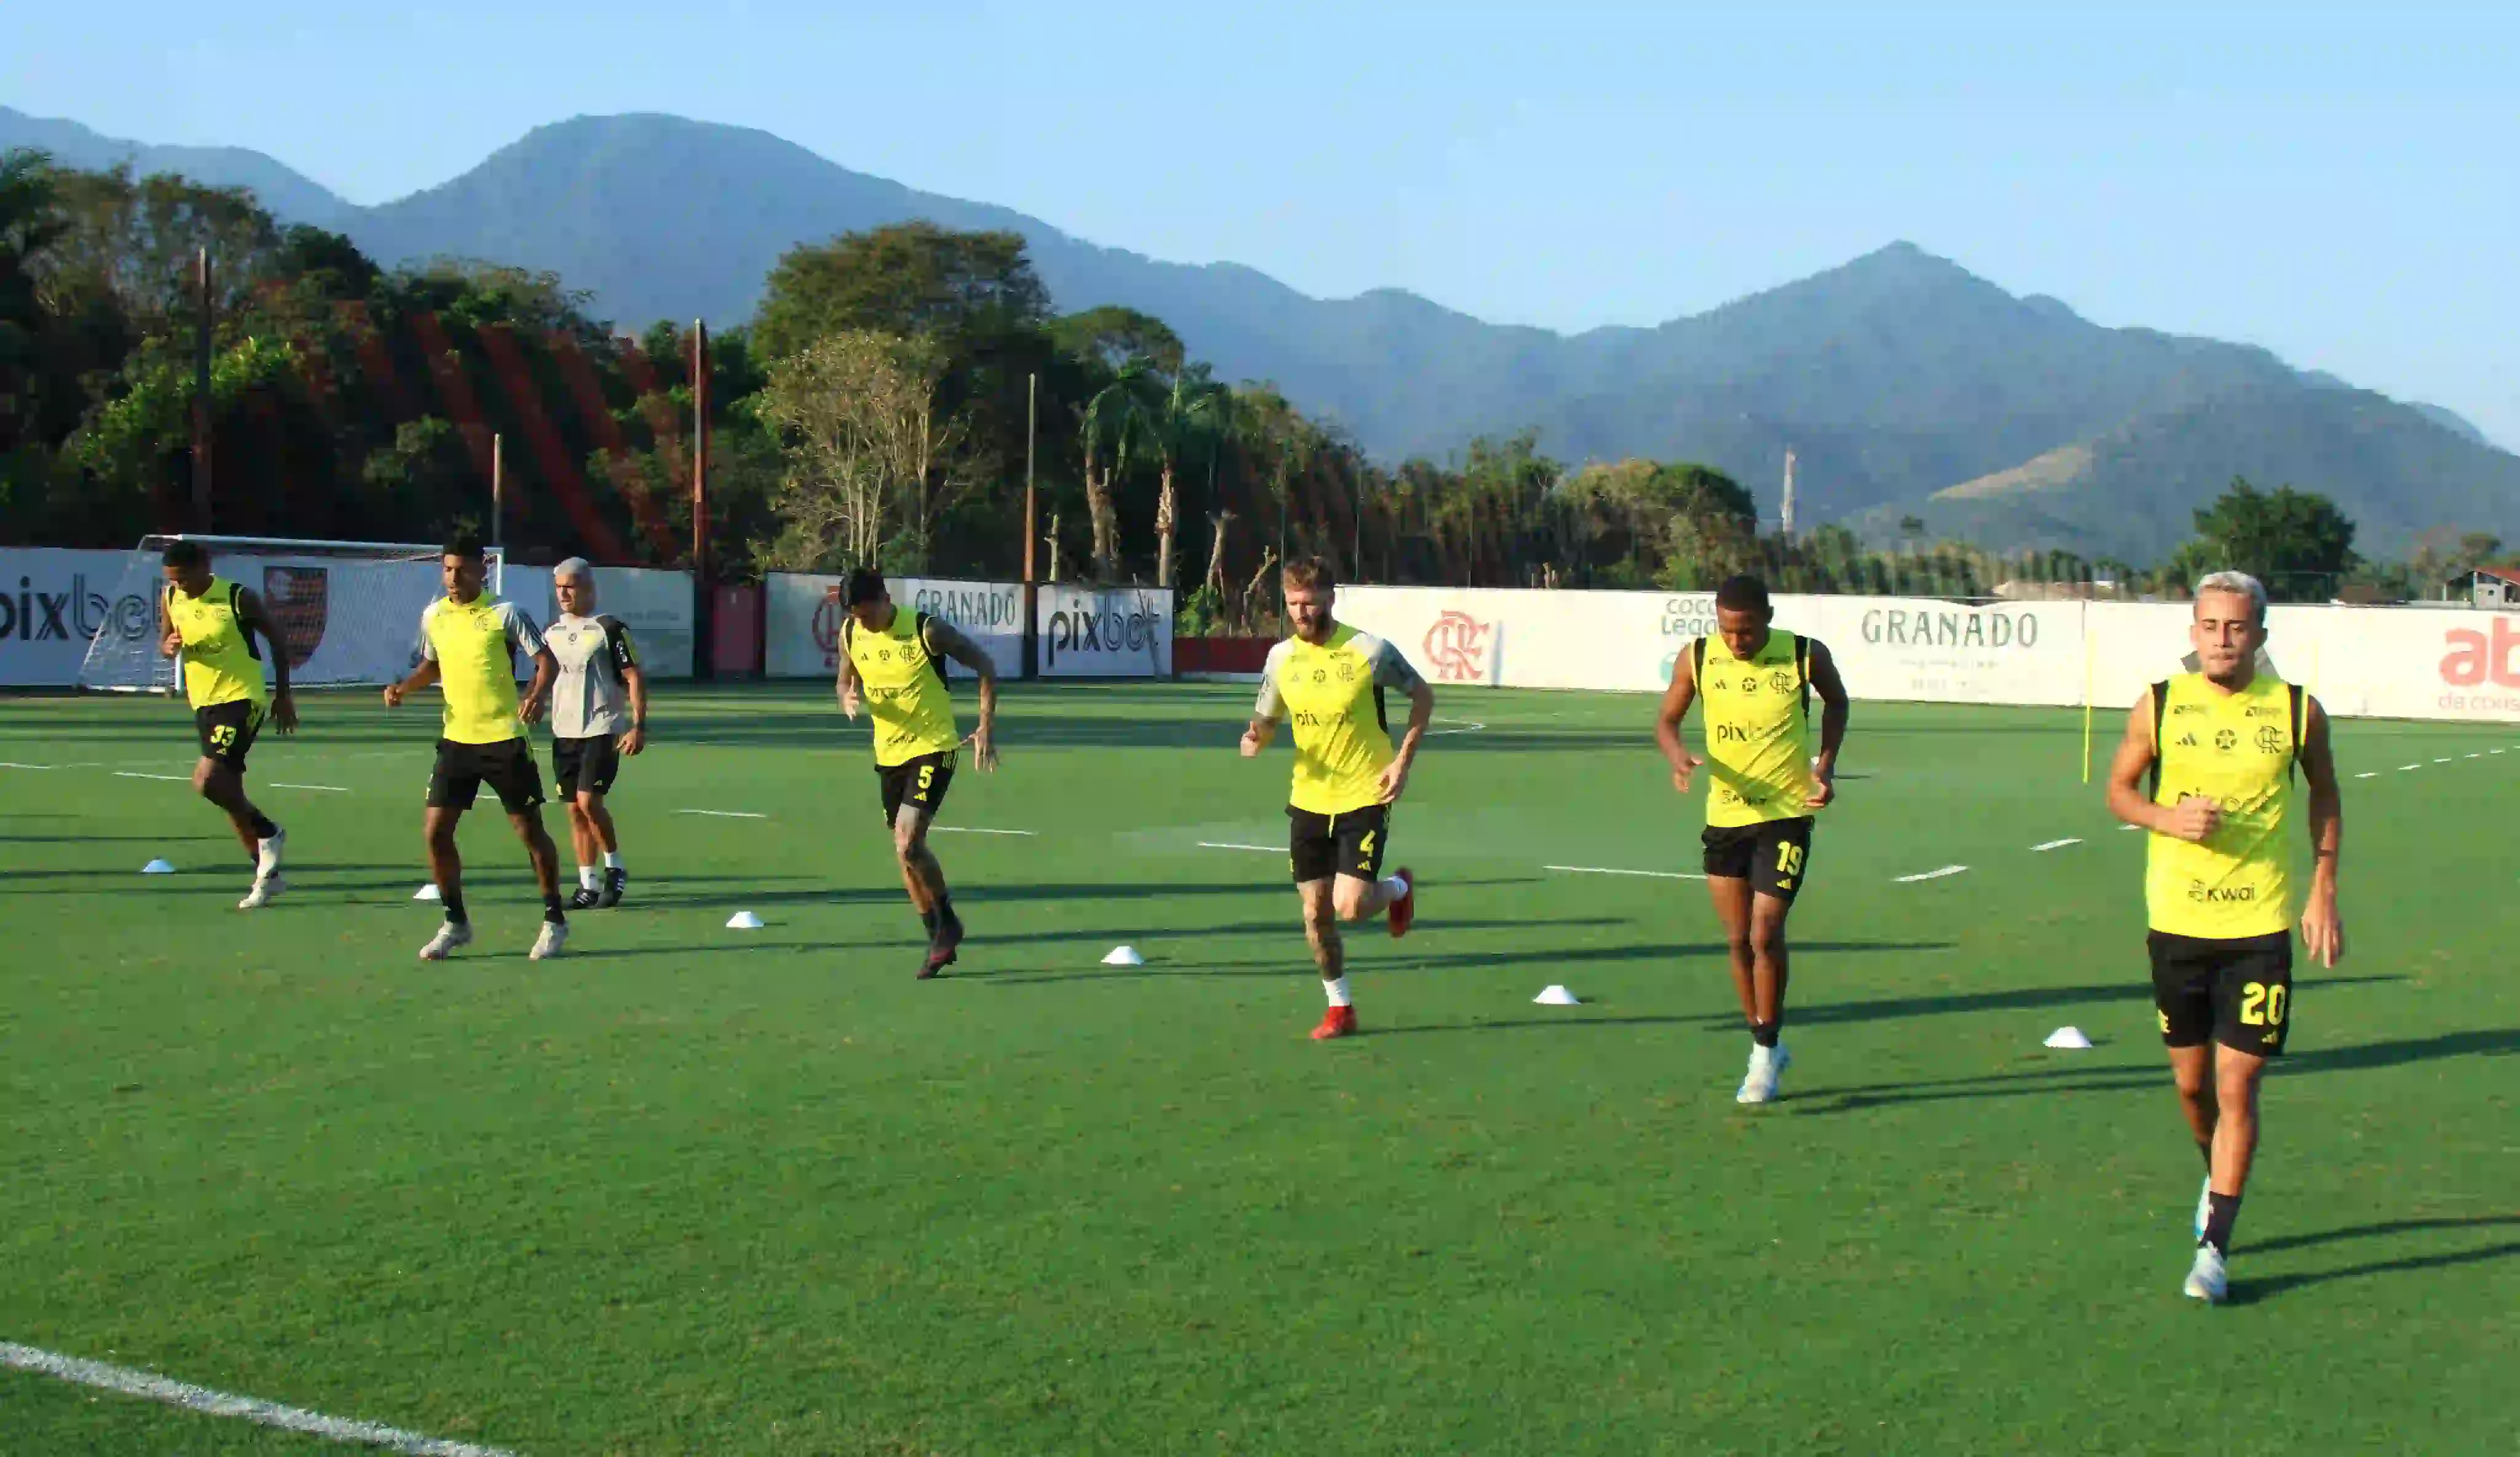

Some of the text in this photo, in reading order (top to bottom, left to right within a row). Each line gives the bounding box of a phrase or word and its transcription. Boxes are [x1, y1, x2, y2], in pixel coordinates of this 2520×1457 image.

[1862, 610, 2038, 647] GRANADO
[918, 765, 934, 788] 5
[1360, 829, 1376, 857] 4
[1777, 841, 1803, 876] 19
[2241, 982, 2285, 1026] 20
